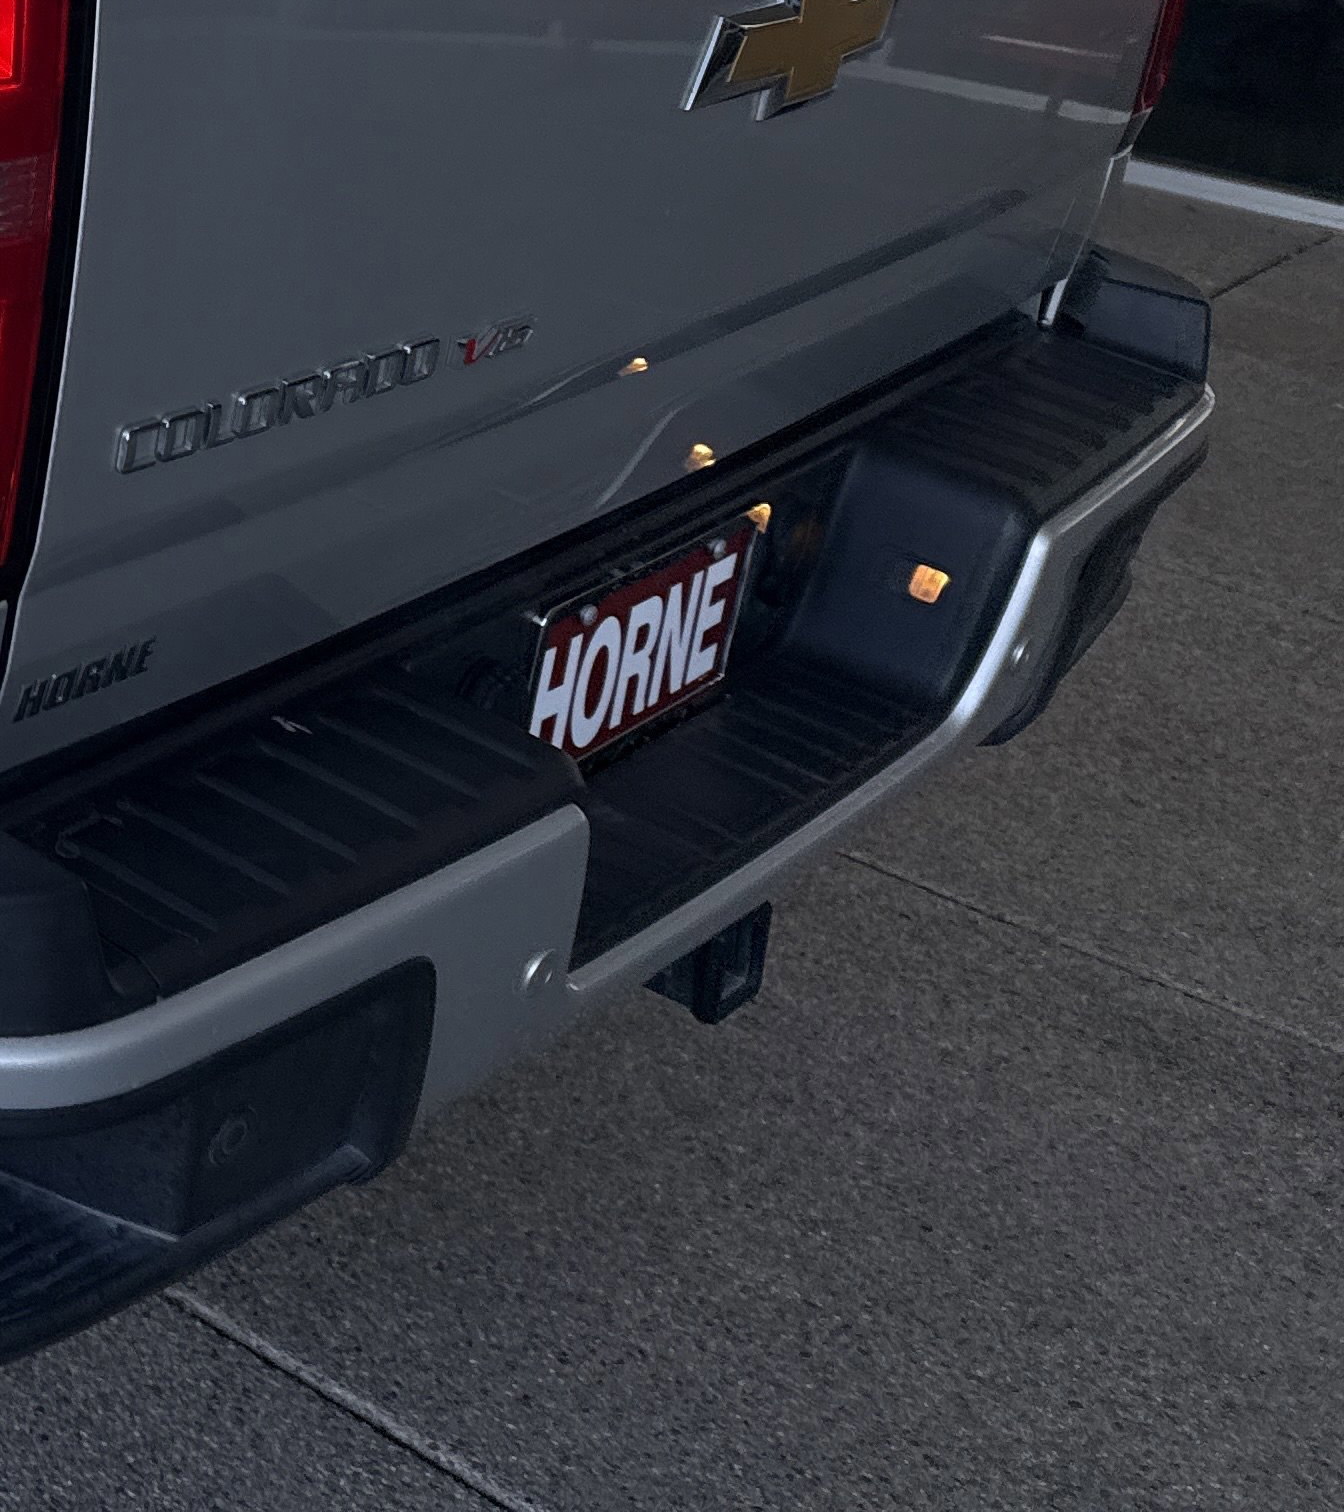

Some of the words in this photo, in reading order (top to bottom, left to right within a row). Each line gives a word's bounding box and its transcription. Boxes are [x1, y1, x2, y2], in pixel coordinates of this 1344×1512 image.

[114, 336, 442, 475] COLORADO
[13, 635, 159, 724] HORNE
[528, 551, 739, 751] HORNE
